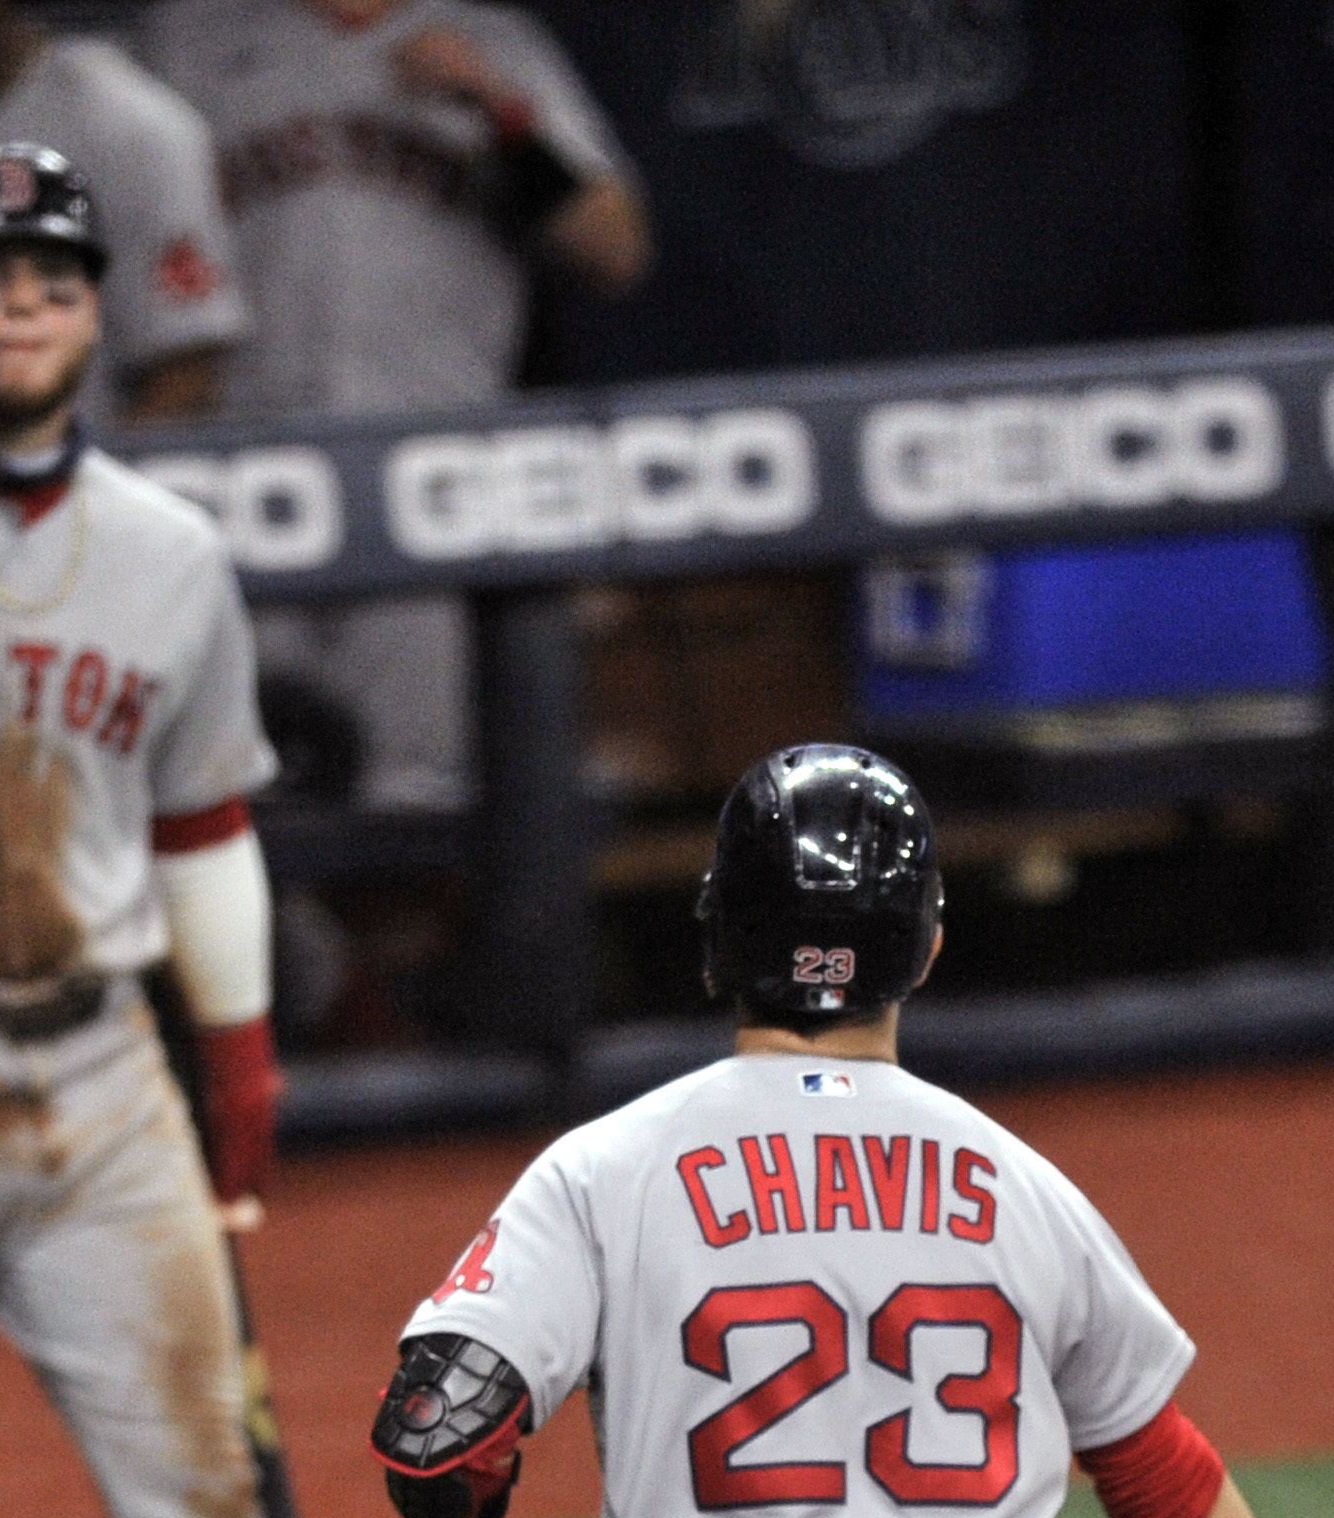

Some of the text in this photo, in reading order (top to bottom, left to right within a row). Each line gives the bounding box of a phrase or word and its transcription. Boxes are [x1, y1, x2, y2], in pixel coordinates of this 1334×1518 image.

[382, 408, 814, 558] GEICO
[861, 377, 1280, 521] GEICO
[792, 945, 856, 984] 23
[676, 1133, 998, 1249] CHAVIS
[680, 1279, 1024, 1512] 23
